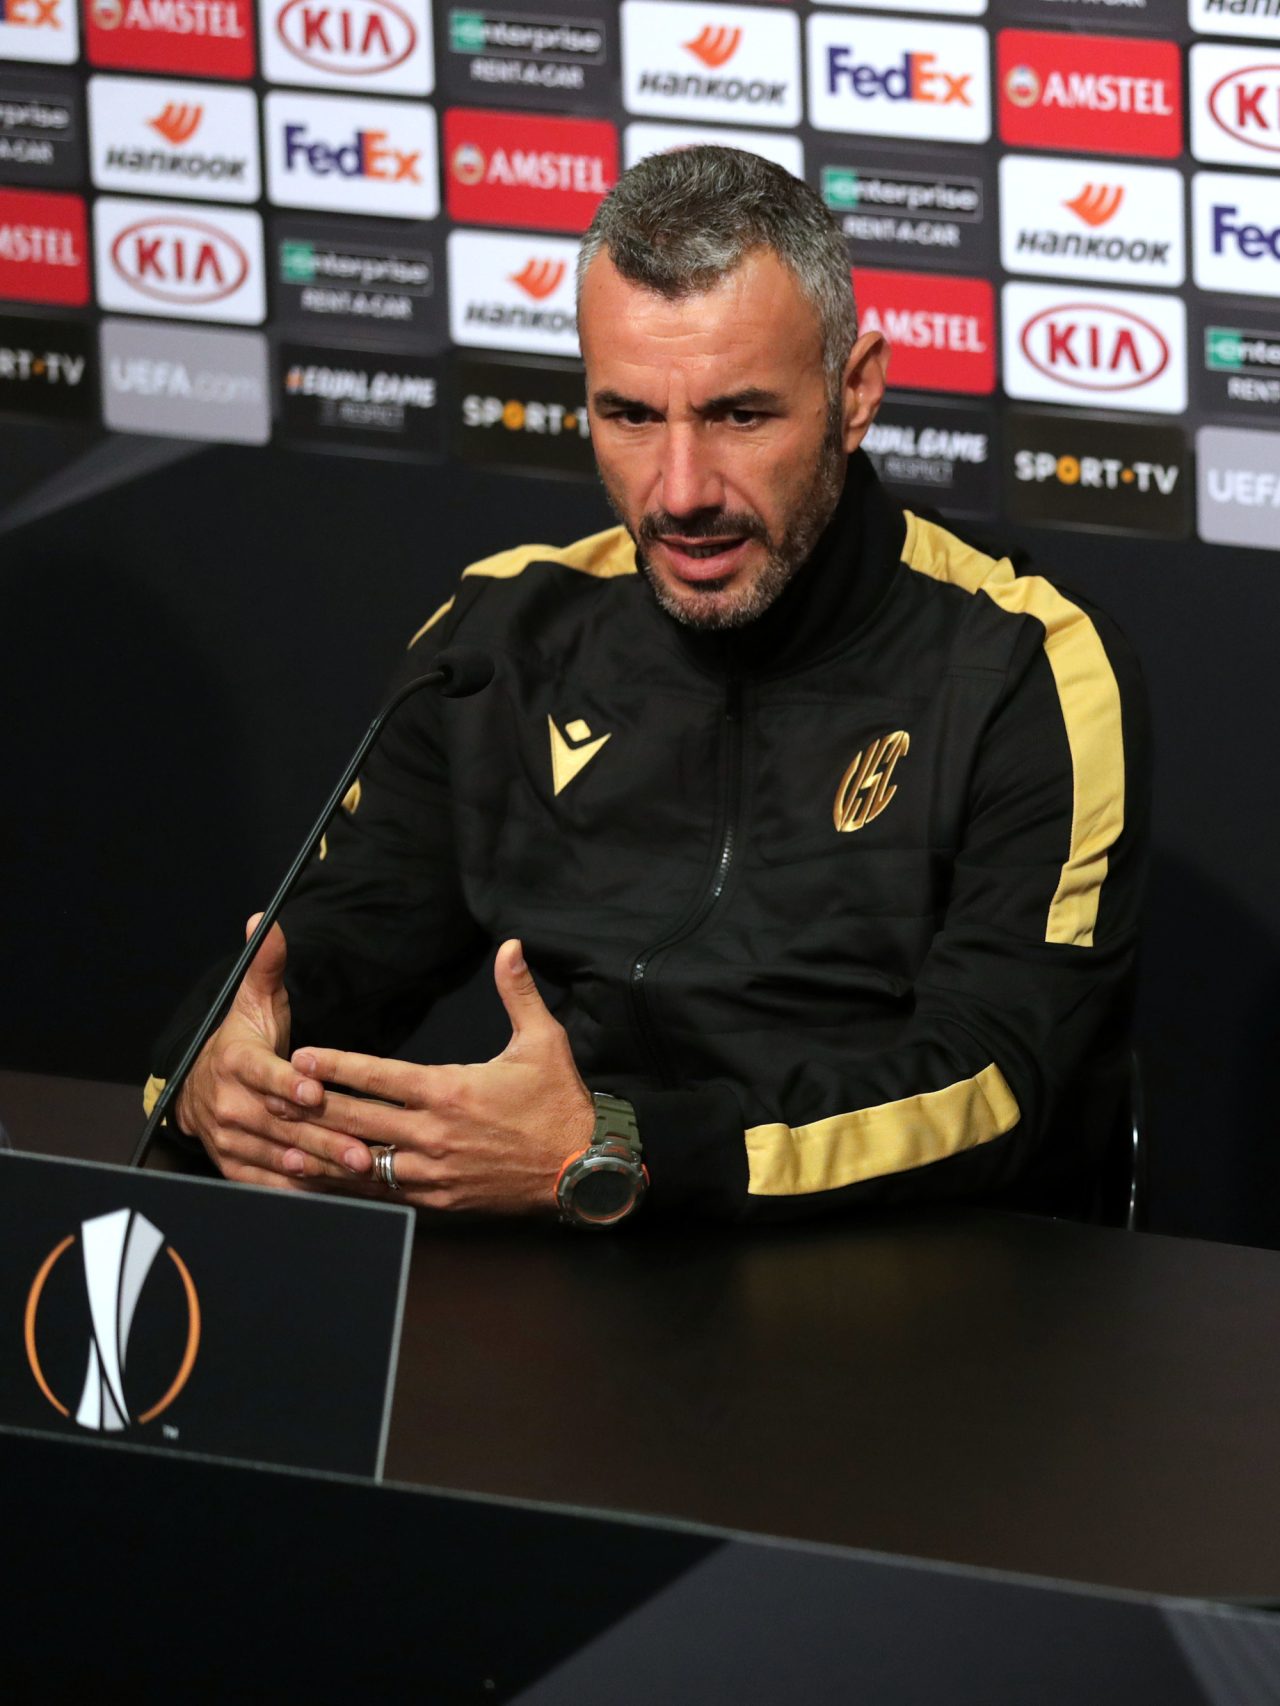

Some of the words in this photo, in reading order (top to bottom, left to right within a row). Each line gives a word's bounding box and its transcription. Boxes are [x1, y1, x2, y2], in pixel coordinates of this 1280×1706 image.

[123, 0, 245, 39] AMSTEL
[302, 8, 393, 56] KIA
[826, 46, 972, 107] FedEx
[1042, 71, 1173, 116] AMSTEL
[282, 124, 422, 184] FedEx
[486, 148, 608, 193] AMSTEL
[835, 178, 979, 212] enterprise
[136, 237, 224, 285] KIA
[858, 306, 986, 353] AMSTEL
[1046, 322, 1144, 374] KIA
